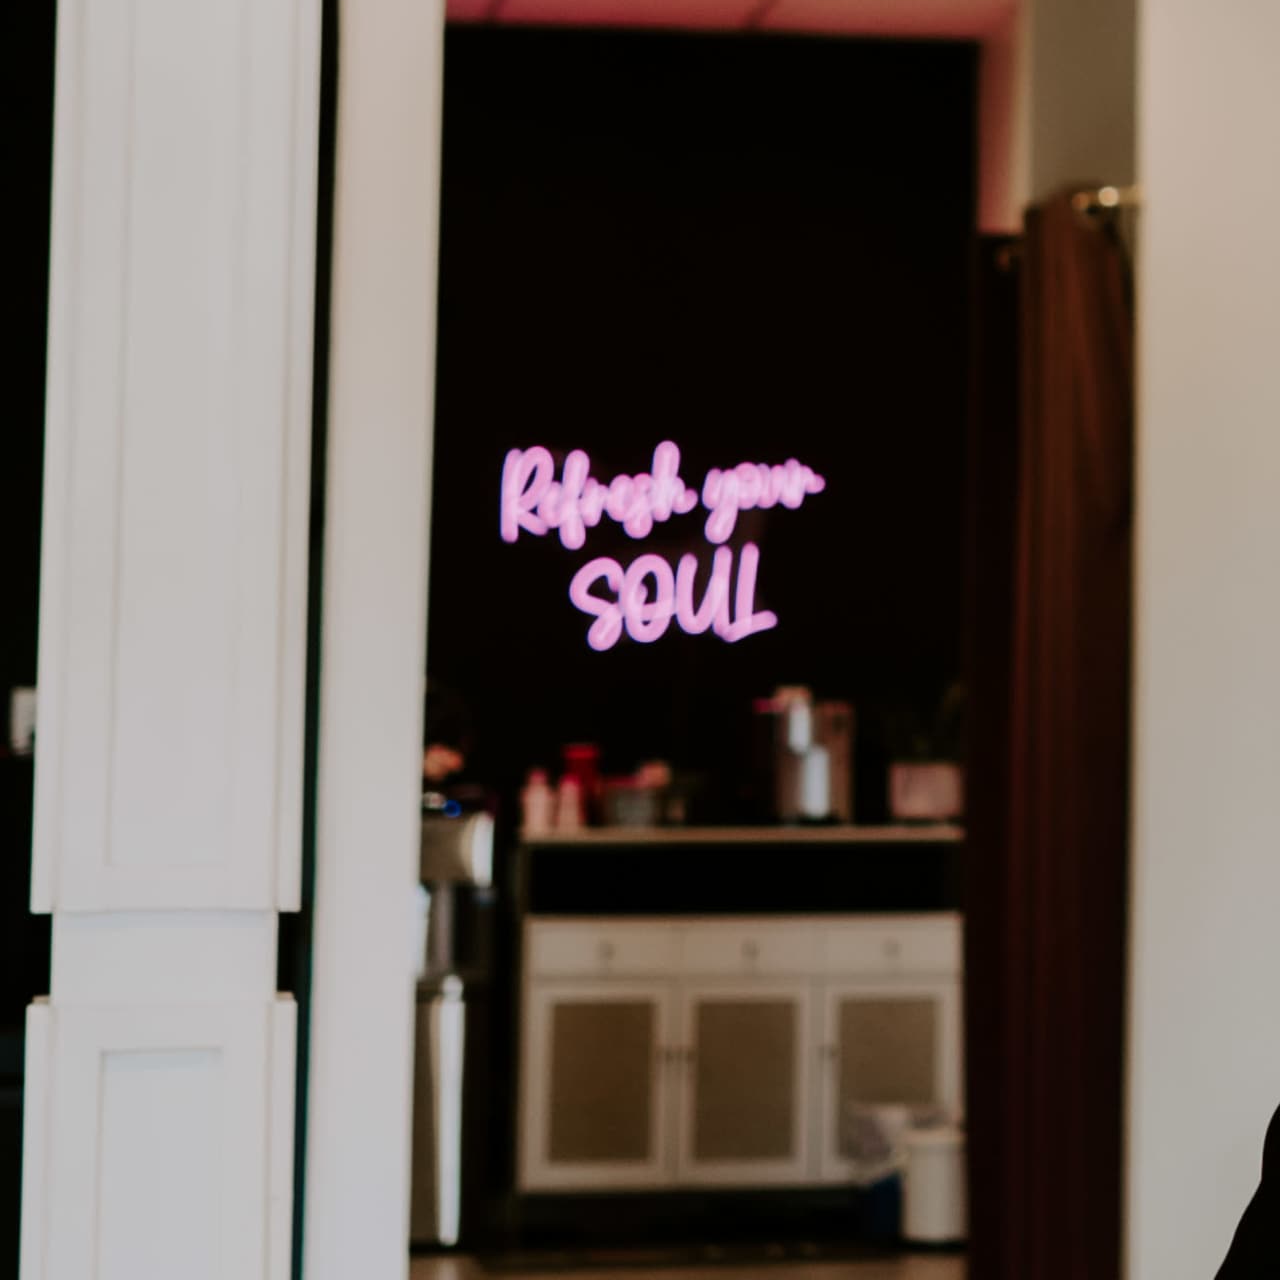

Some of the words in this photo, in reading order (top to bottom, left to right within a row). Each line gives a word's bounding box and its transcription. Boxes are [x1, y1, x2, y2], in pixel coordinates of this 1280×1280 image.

[500, 440, 697, 549] Refresh
[702, 458, 826, 544] your
[569, 542, 778, 651] SOUL
